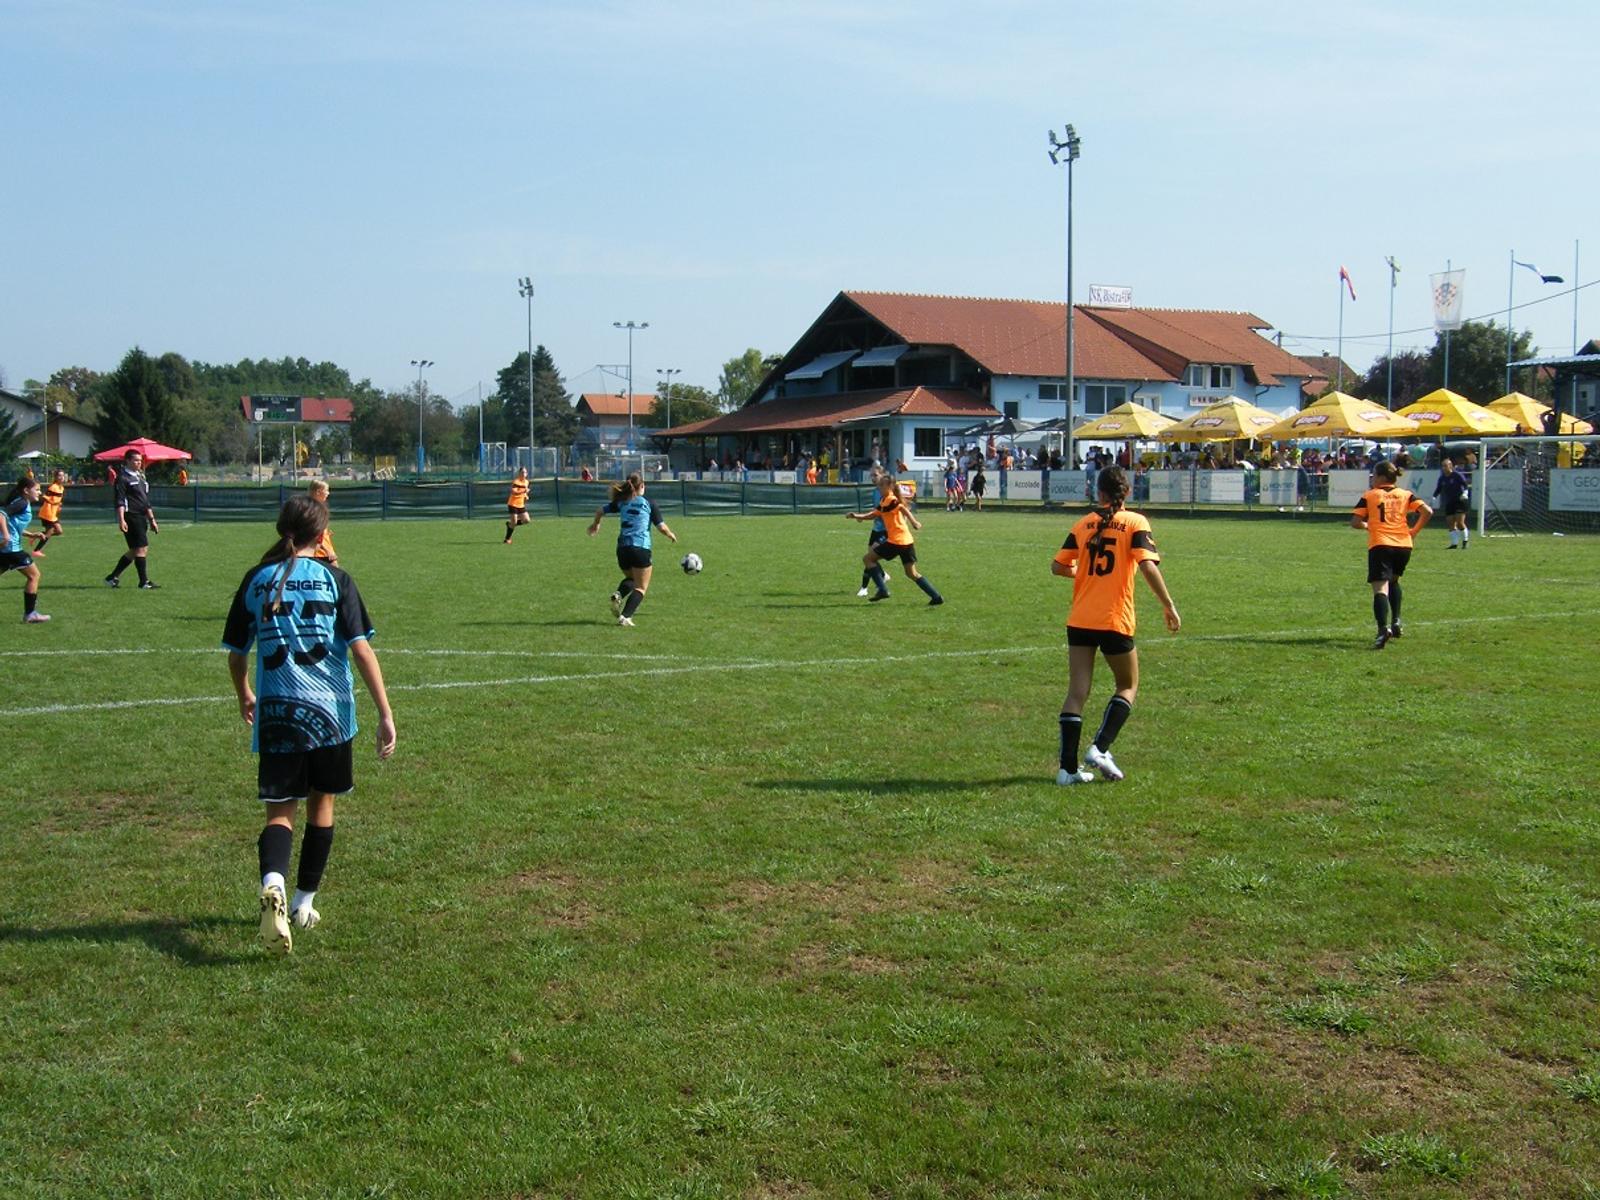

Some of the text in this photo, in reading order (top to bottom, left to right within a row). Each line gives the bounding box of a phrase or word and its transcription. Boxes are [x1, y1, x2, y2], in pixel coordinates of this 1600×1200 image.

[1014, 480, 1040, 489] Accolade
[1086, 537, 1117, 577] 15
[285, 579, 333, 592] SIGET
